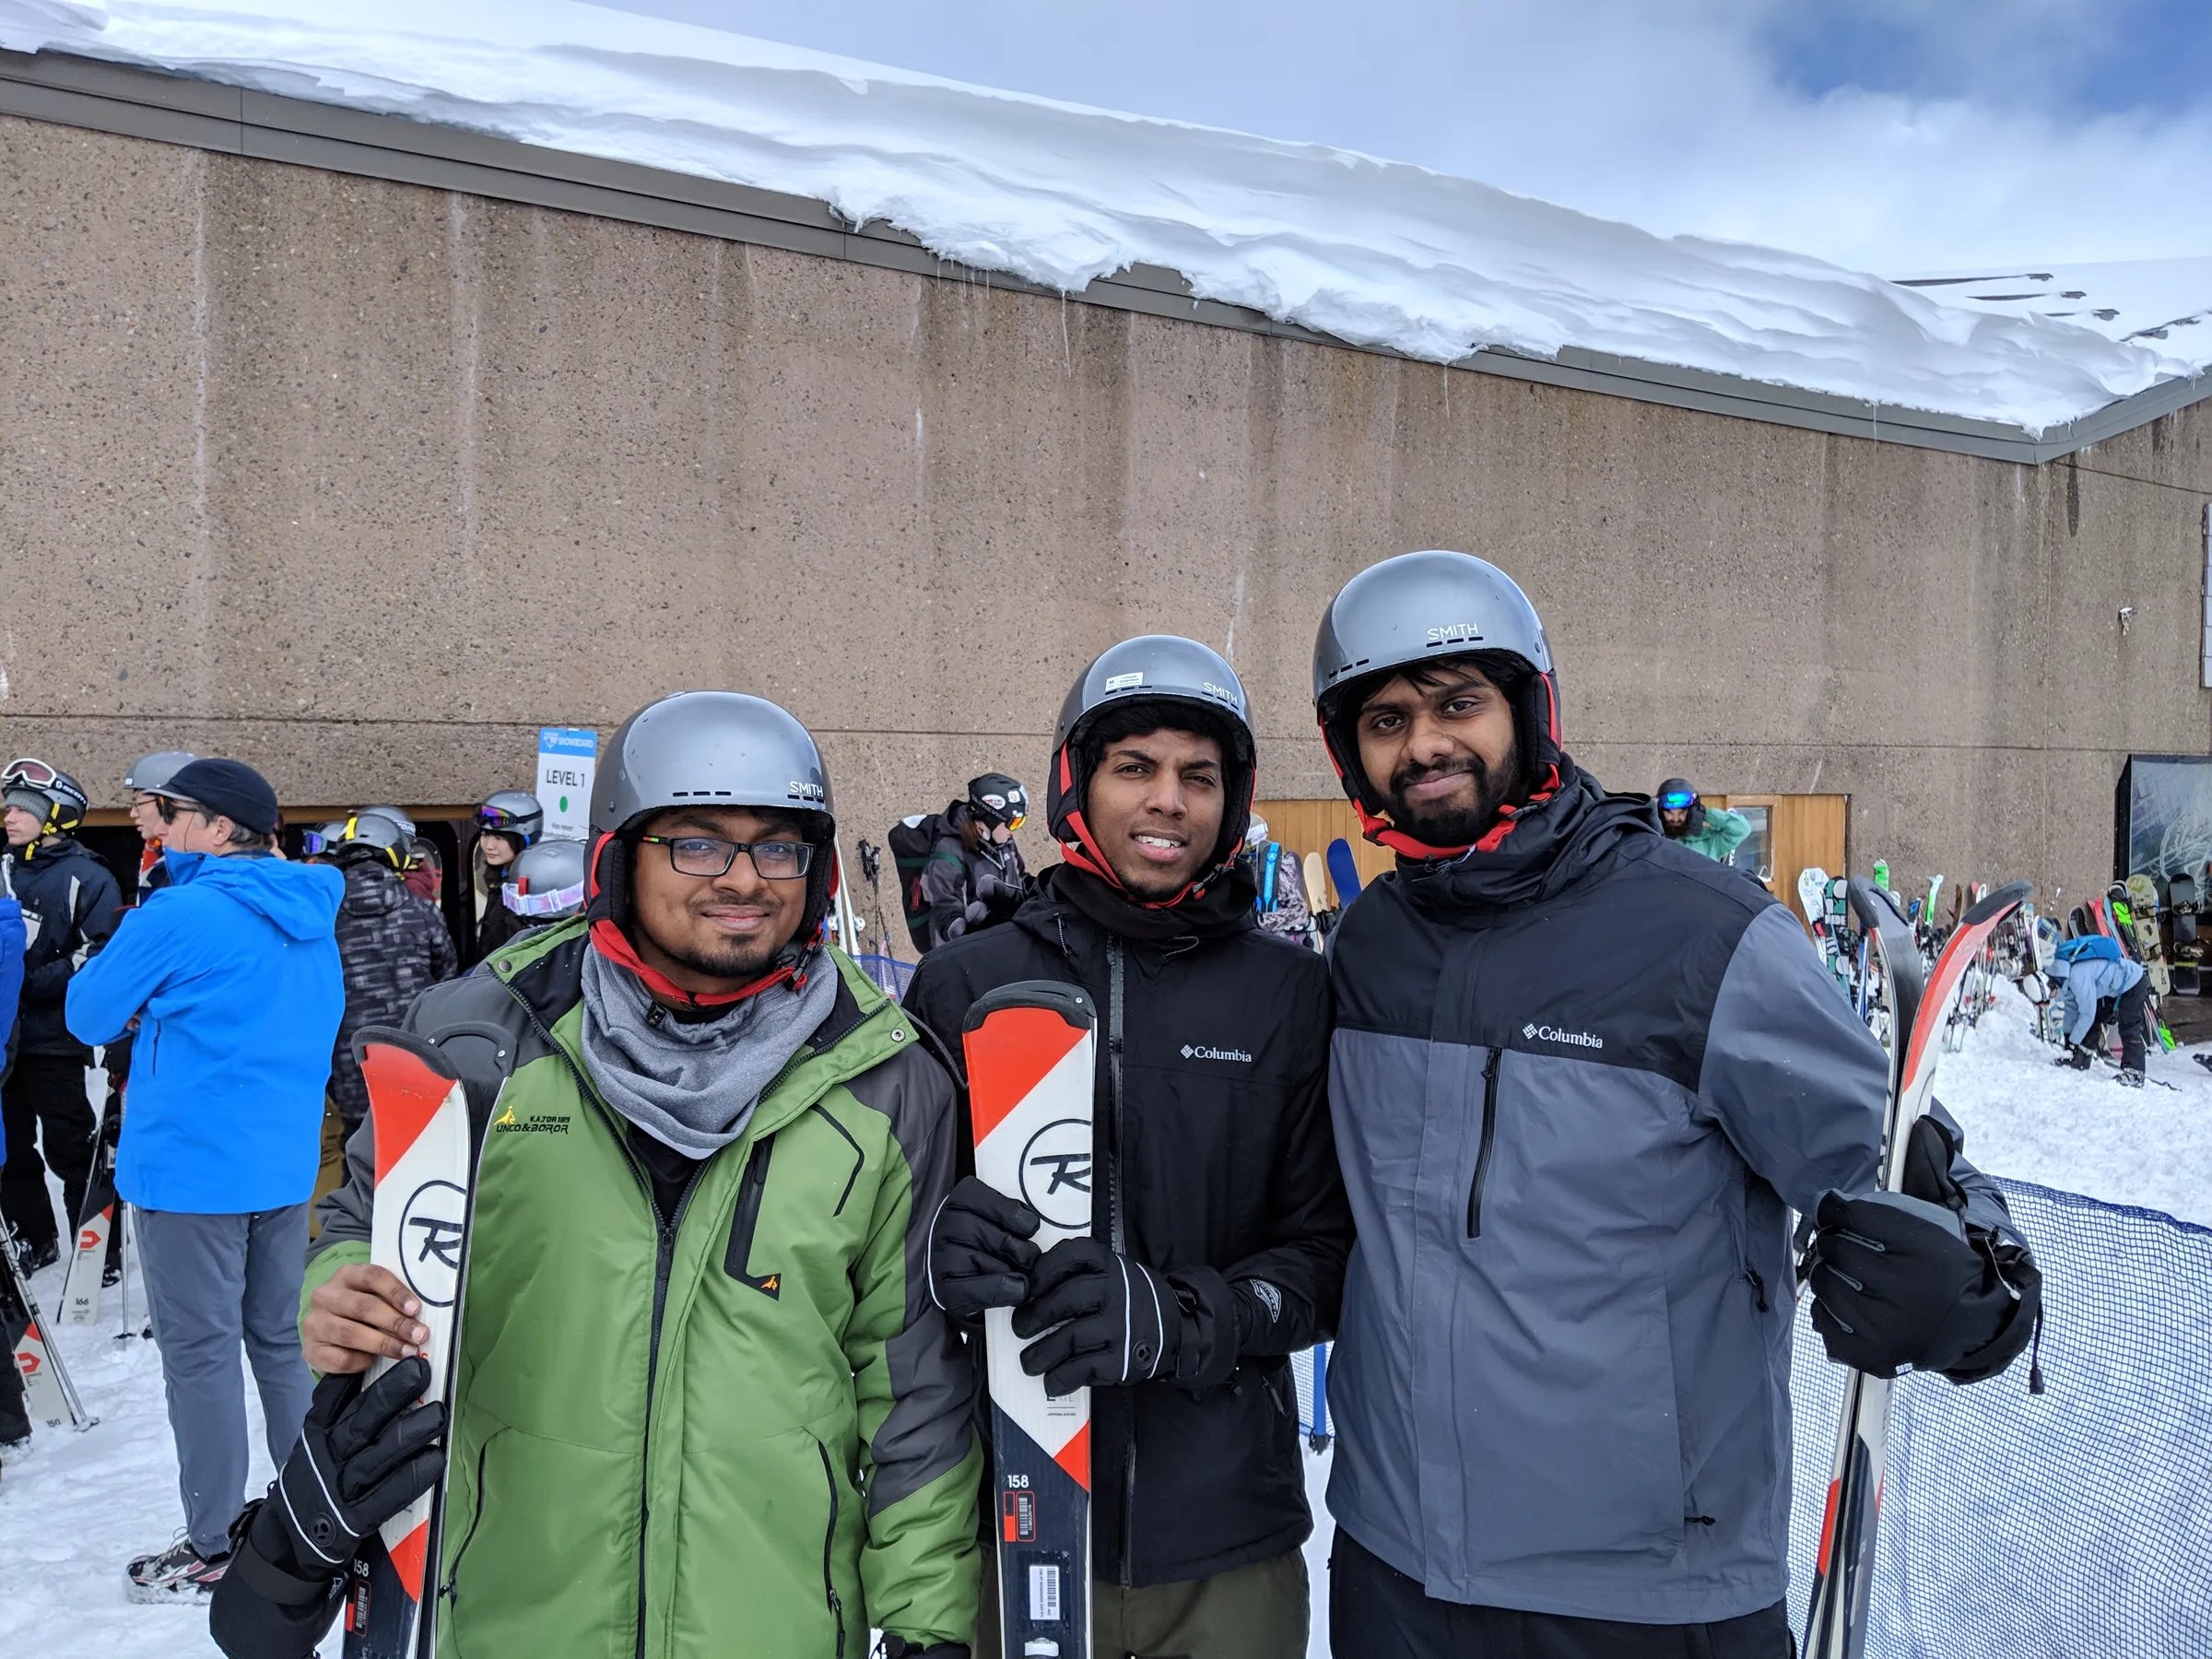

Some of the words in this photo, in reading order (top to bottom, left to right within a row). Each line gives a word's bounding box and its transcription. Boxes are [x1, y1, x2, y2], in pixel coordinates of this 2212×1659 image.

[1427, 623, 1479, 641] SMITH
[1203, 682, 1238, 704] SMITH
[546, 769, 578, 786] LEVEL
[581, 772, 586, 788] 1
[789, 781, 824, 797] SMITH
[1538, 1026, 1604, 1048] Columbia
[1194, 1046, 1253, 1062] Columbia
[76, 1297, 89, 1306] 166
[46, 1418, 61, 1428] 150
[1007, 1475, 1030, 1488] 158
[353, 1559, 370, 1577] 158
